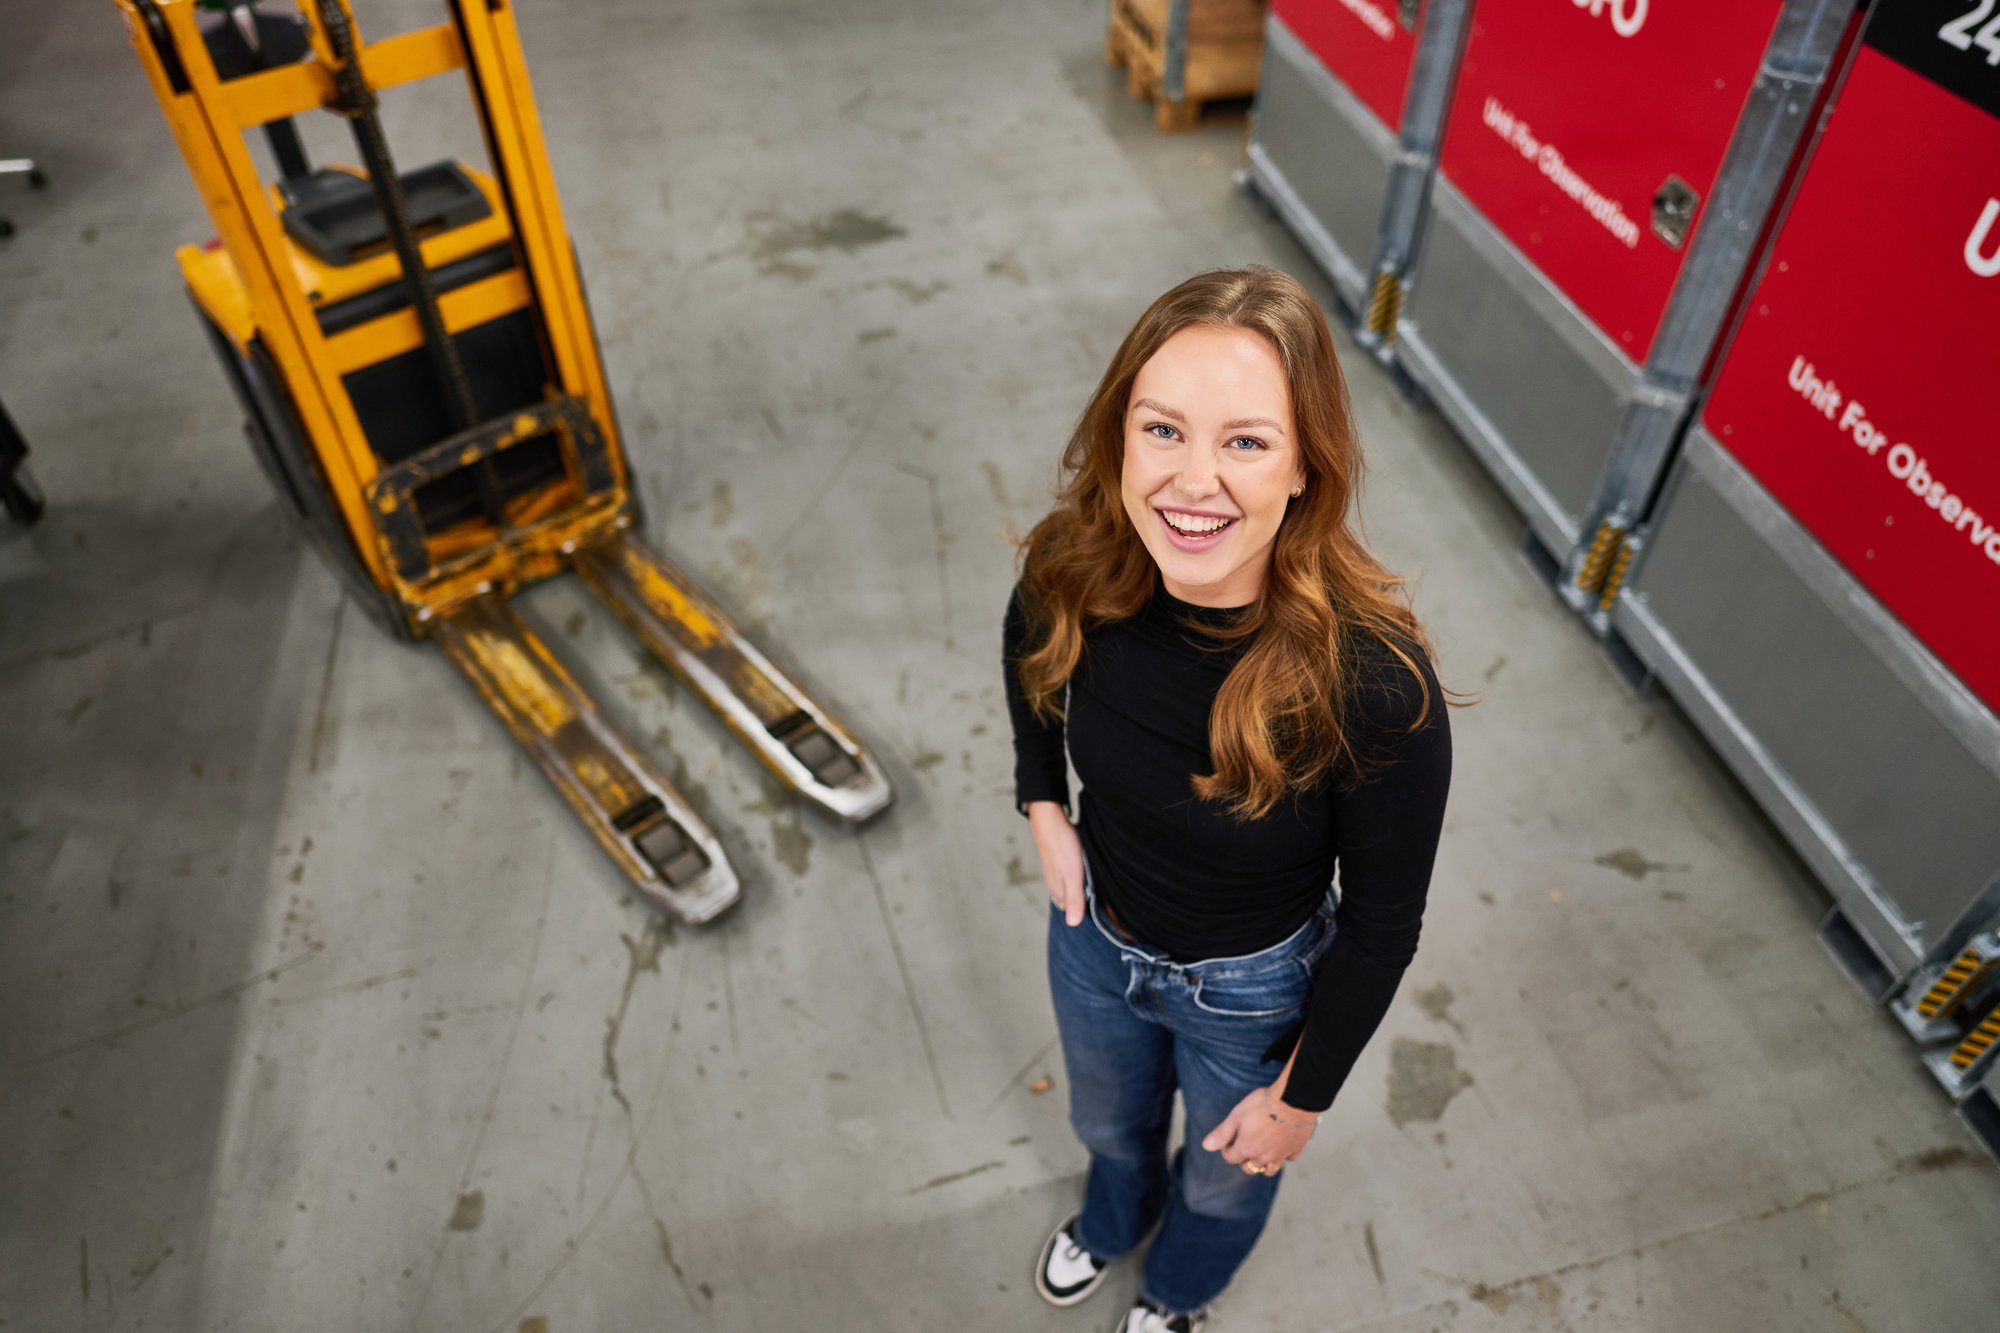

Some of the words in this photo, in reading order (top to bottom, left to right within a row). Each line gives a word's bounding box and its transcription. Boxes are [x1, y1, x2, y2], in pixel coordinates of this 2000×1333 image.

[1483, 95, 1516, 144] Unit
[1511, 121, 1542, 163] For
[1538, 143, 1640, 249] Observation
[1788, 355, 1842, 420] Unit
[1838, 399, 1888, 455] For
